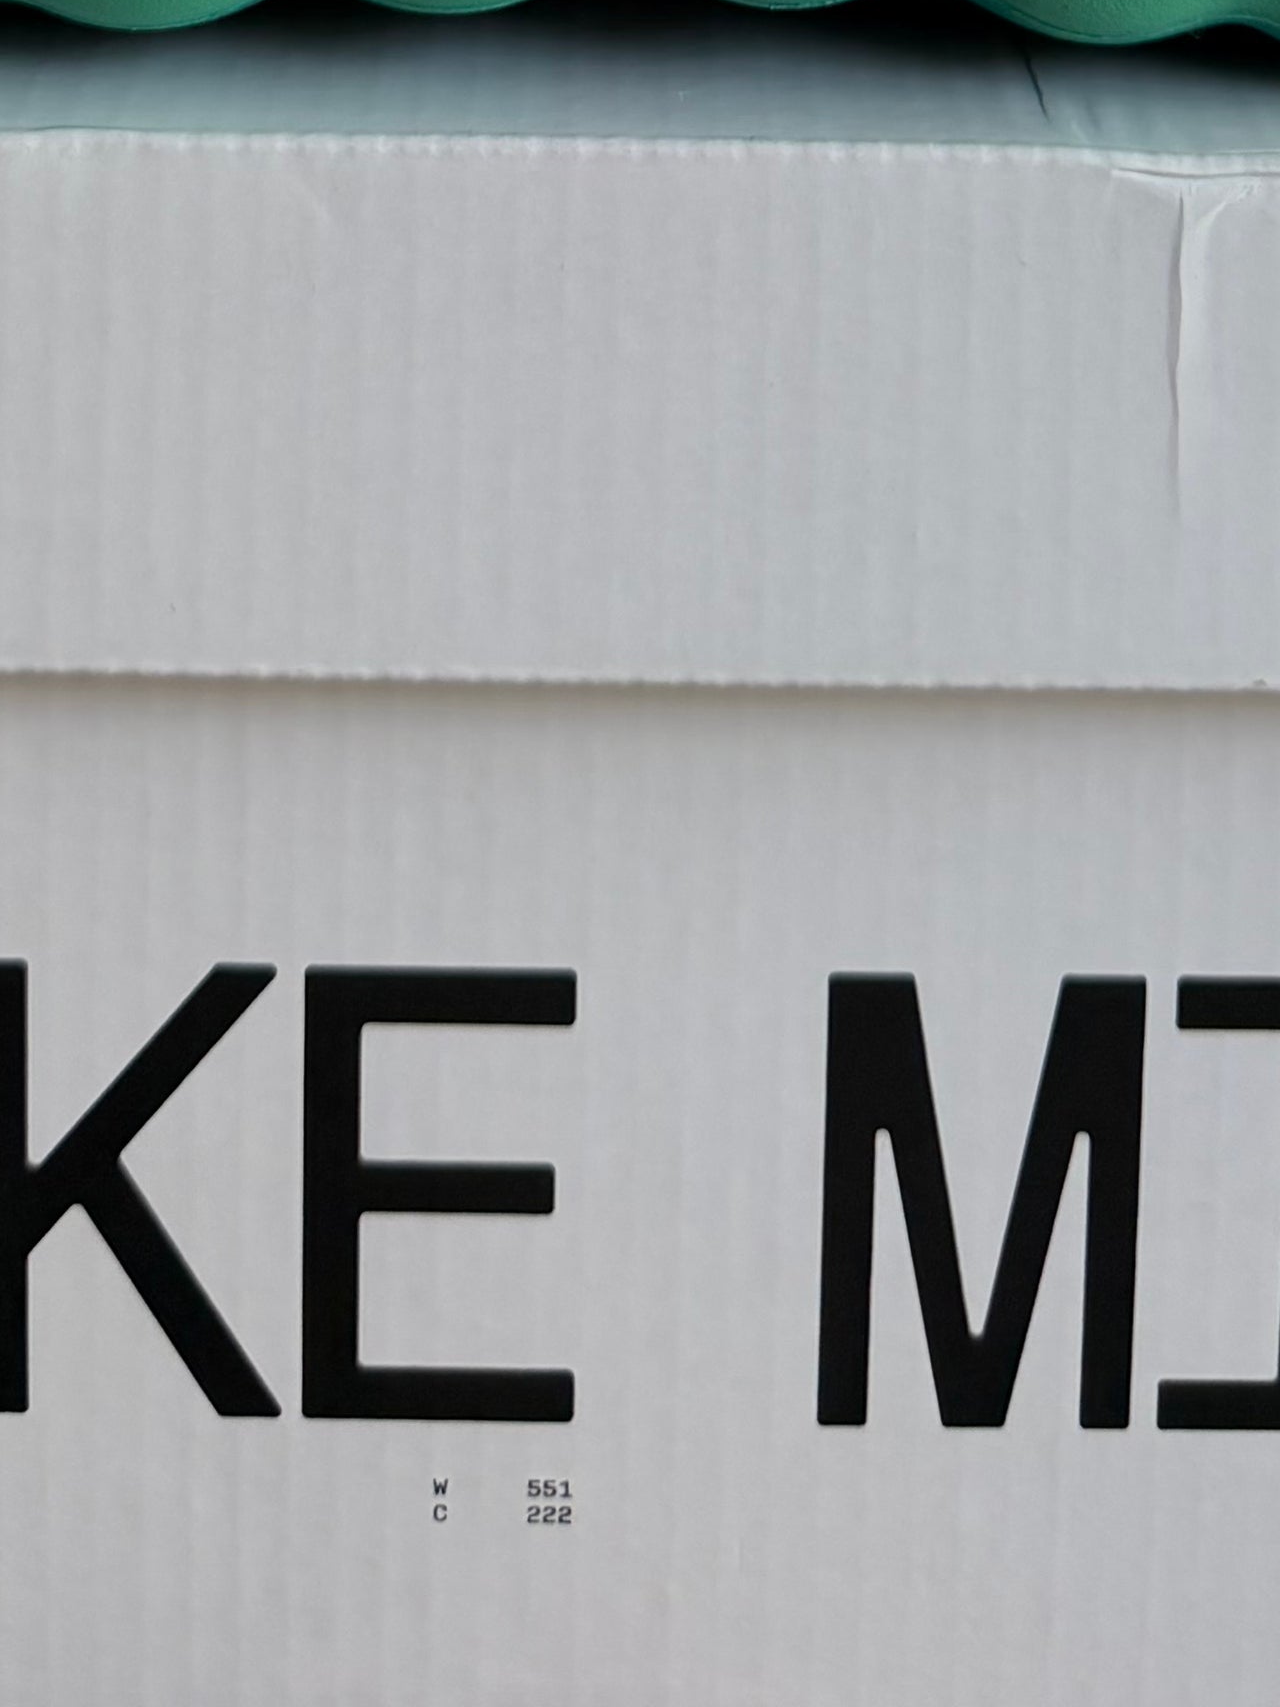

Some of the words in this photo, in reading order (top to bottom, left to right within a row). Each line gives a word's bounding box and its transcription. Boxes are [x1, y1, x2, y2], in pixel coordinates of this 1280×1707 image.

[432, 1478, 449, 1496] W
[527, 1479, 573, 1498] 551
[432, 1503, 448, 1523] C
[526, 1505, 572, 1525] 222
